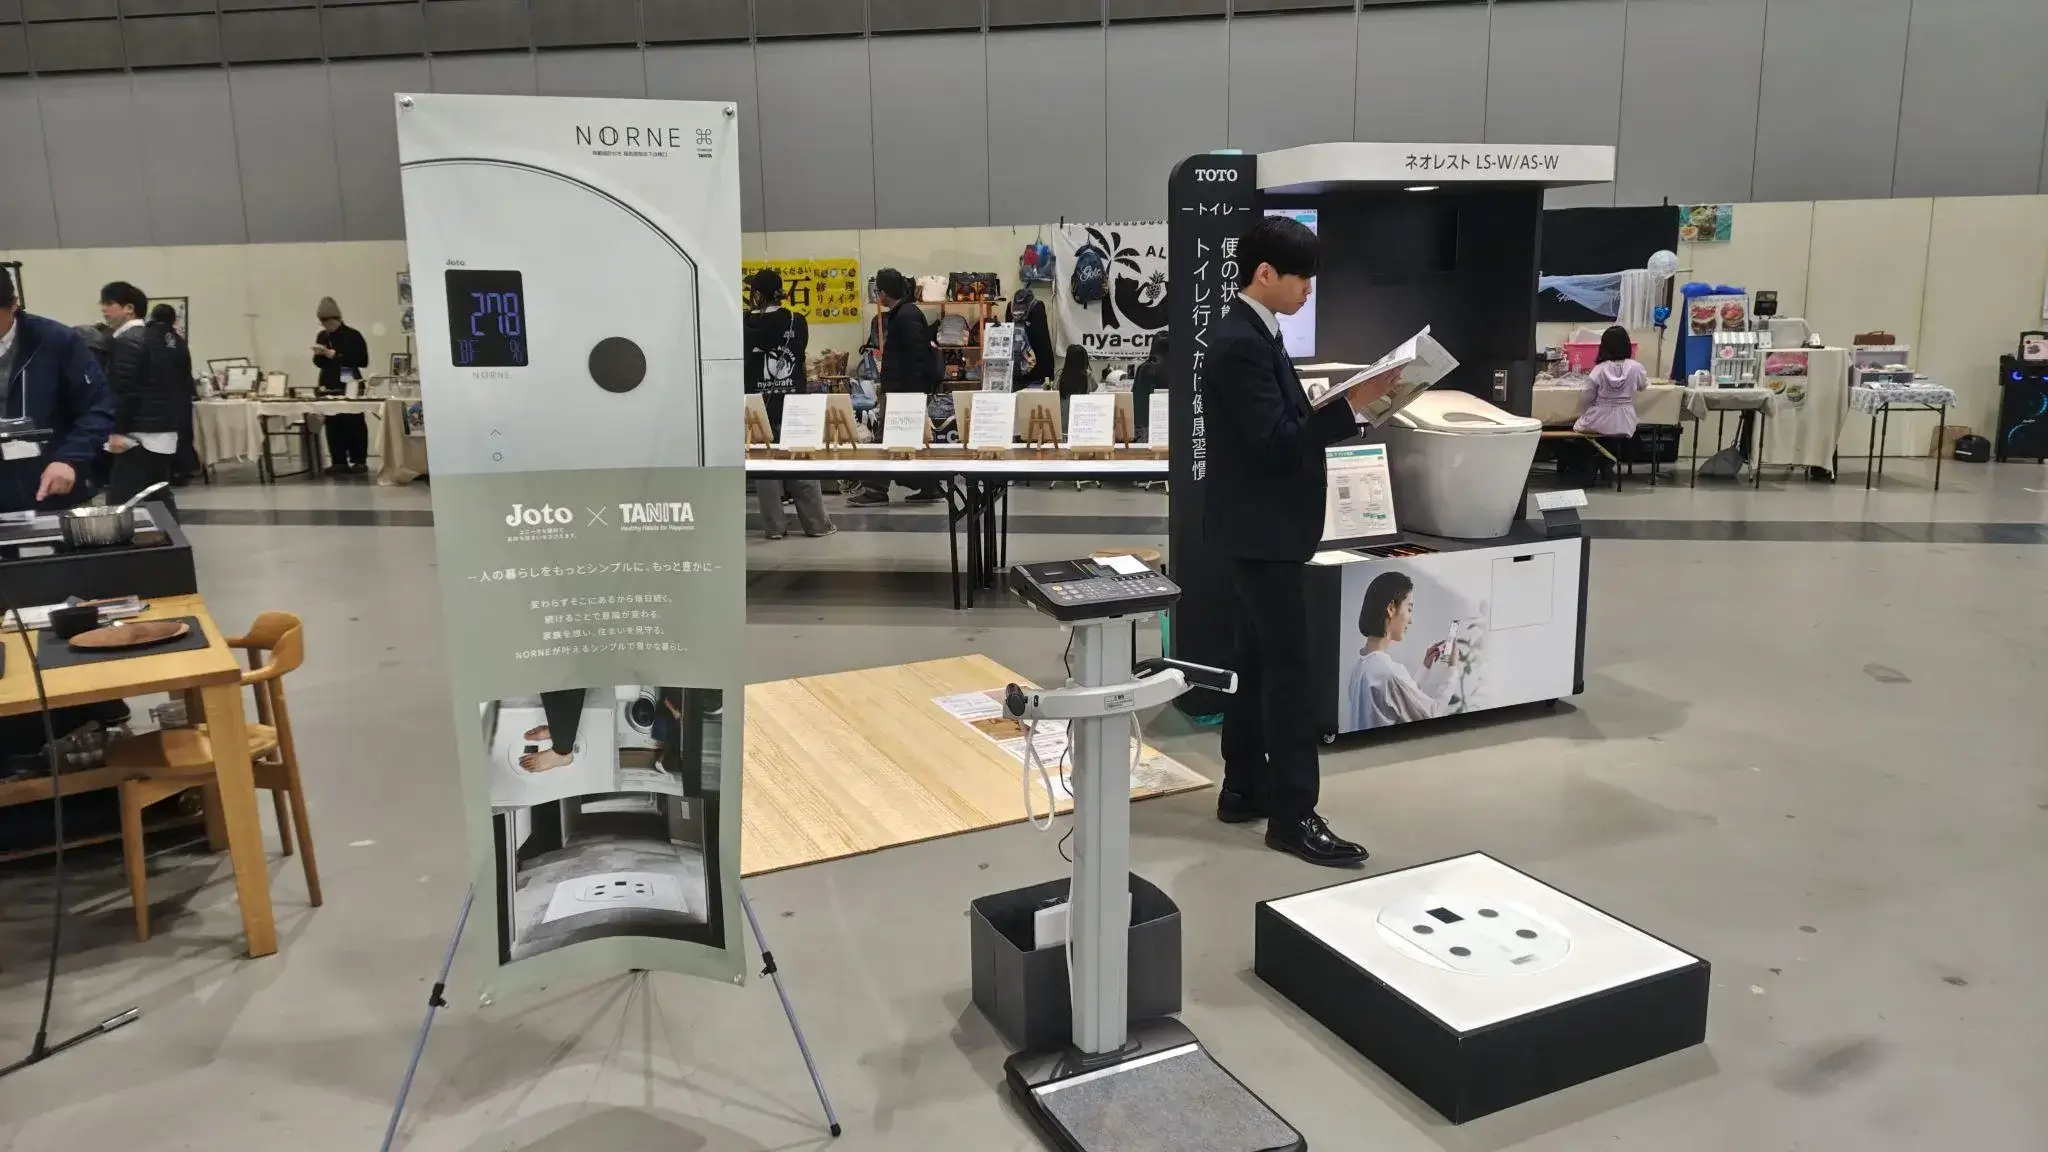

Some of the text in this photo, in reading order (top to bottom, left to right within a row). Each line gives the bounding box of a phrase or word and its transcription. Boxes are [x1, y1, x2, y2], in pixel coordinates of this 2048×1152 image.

[576, 125, 681, 148] NORNE
[1405, 153, 1559, 170] ネオレスト LS-W/AS-W
[1195, 169, 1238, 182] TOTO
[505, 503, 573, 527] Joto
[618, 502, 695, 523] TANITA
